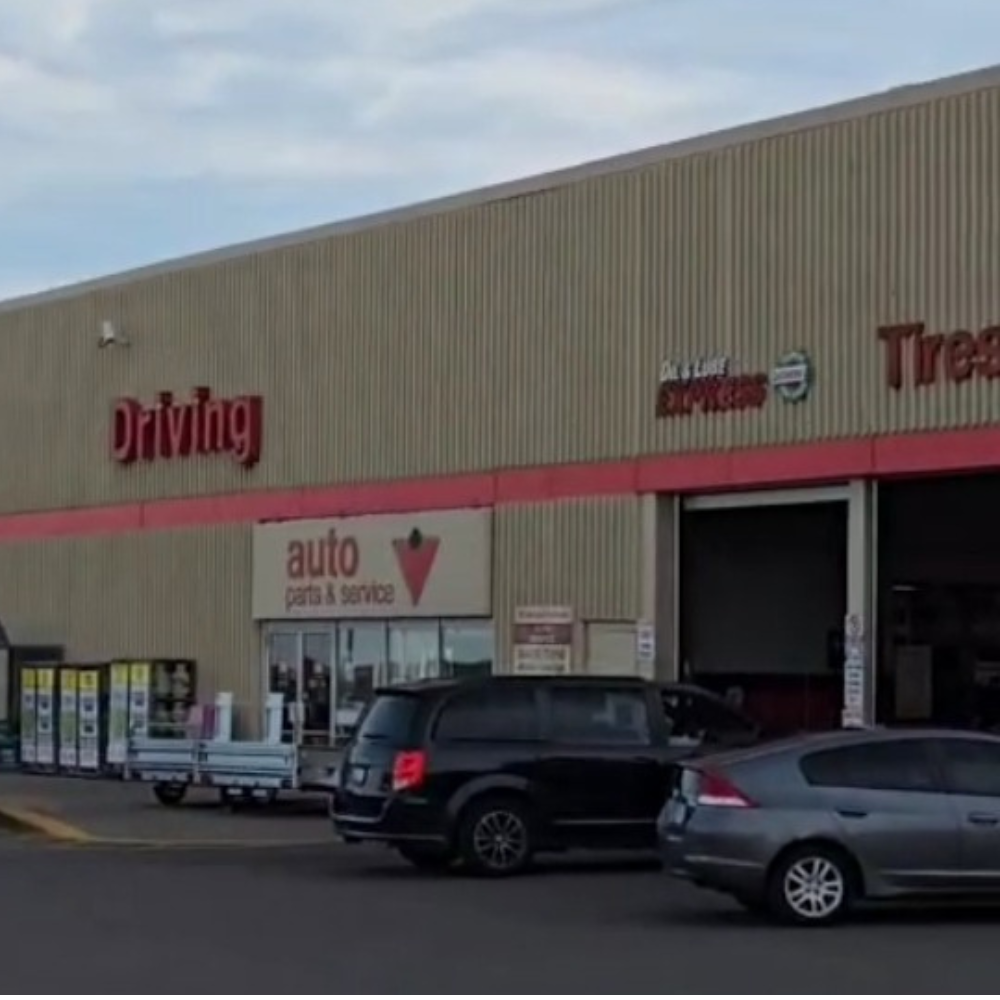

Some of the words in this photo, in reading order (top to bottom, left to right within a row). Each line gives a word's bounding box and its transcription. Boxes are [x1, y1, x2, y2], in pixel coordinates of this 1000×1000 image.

[110, 386, 263, 471] Driving
[287, 528, 360, 579] auto
[285, 583, 322, 611] parts
[326, 584, 337, 605] &
[341, 581, 395, 605] service
